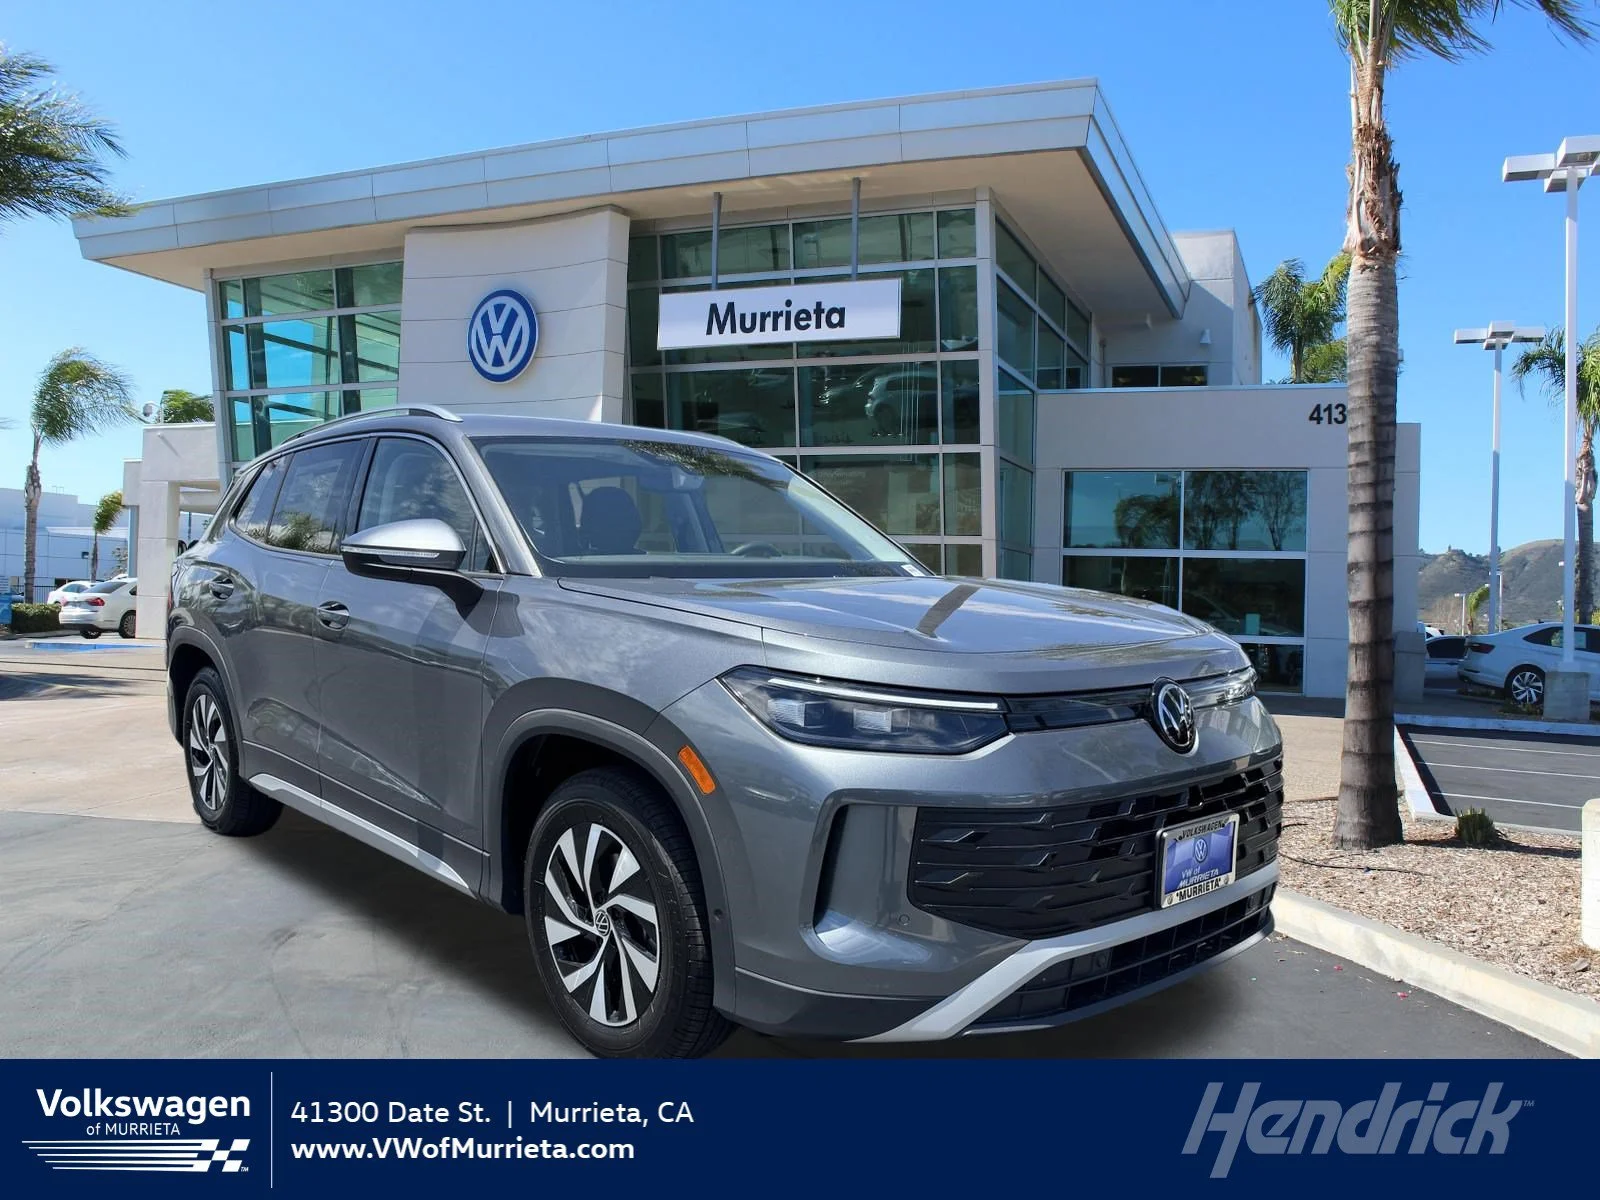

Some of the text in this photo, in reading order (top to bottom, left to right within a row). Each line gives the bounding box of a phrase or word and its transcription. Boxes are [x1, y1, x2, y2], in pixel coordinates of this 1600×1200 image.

[705, 299, 846, 336] Murrieta
[1182, 820, 1223, 838] VOLKSWAGEN
[1177, 868, 1219, 889] MURRIETA
[1181, 868, 1193, 879] VW
